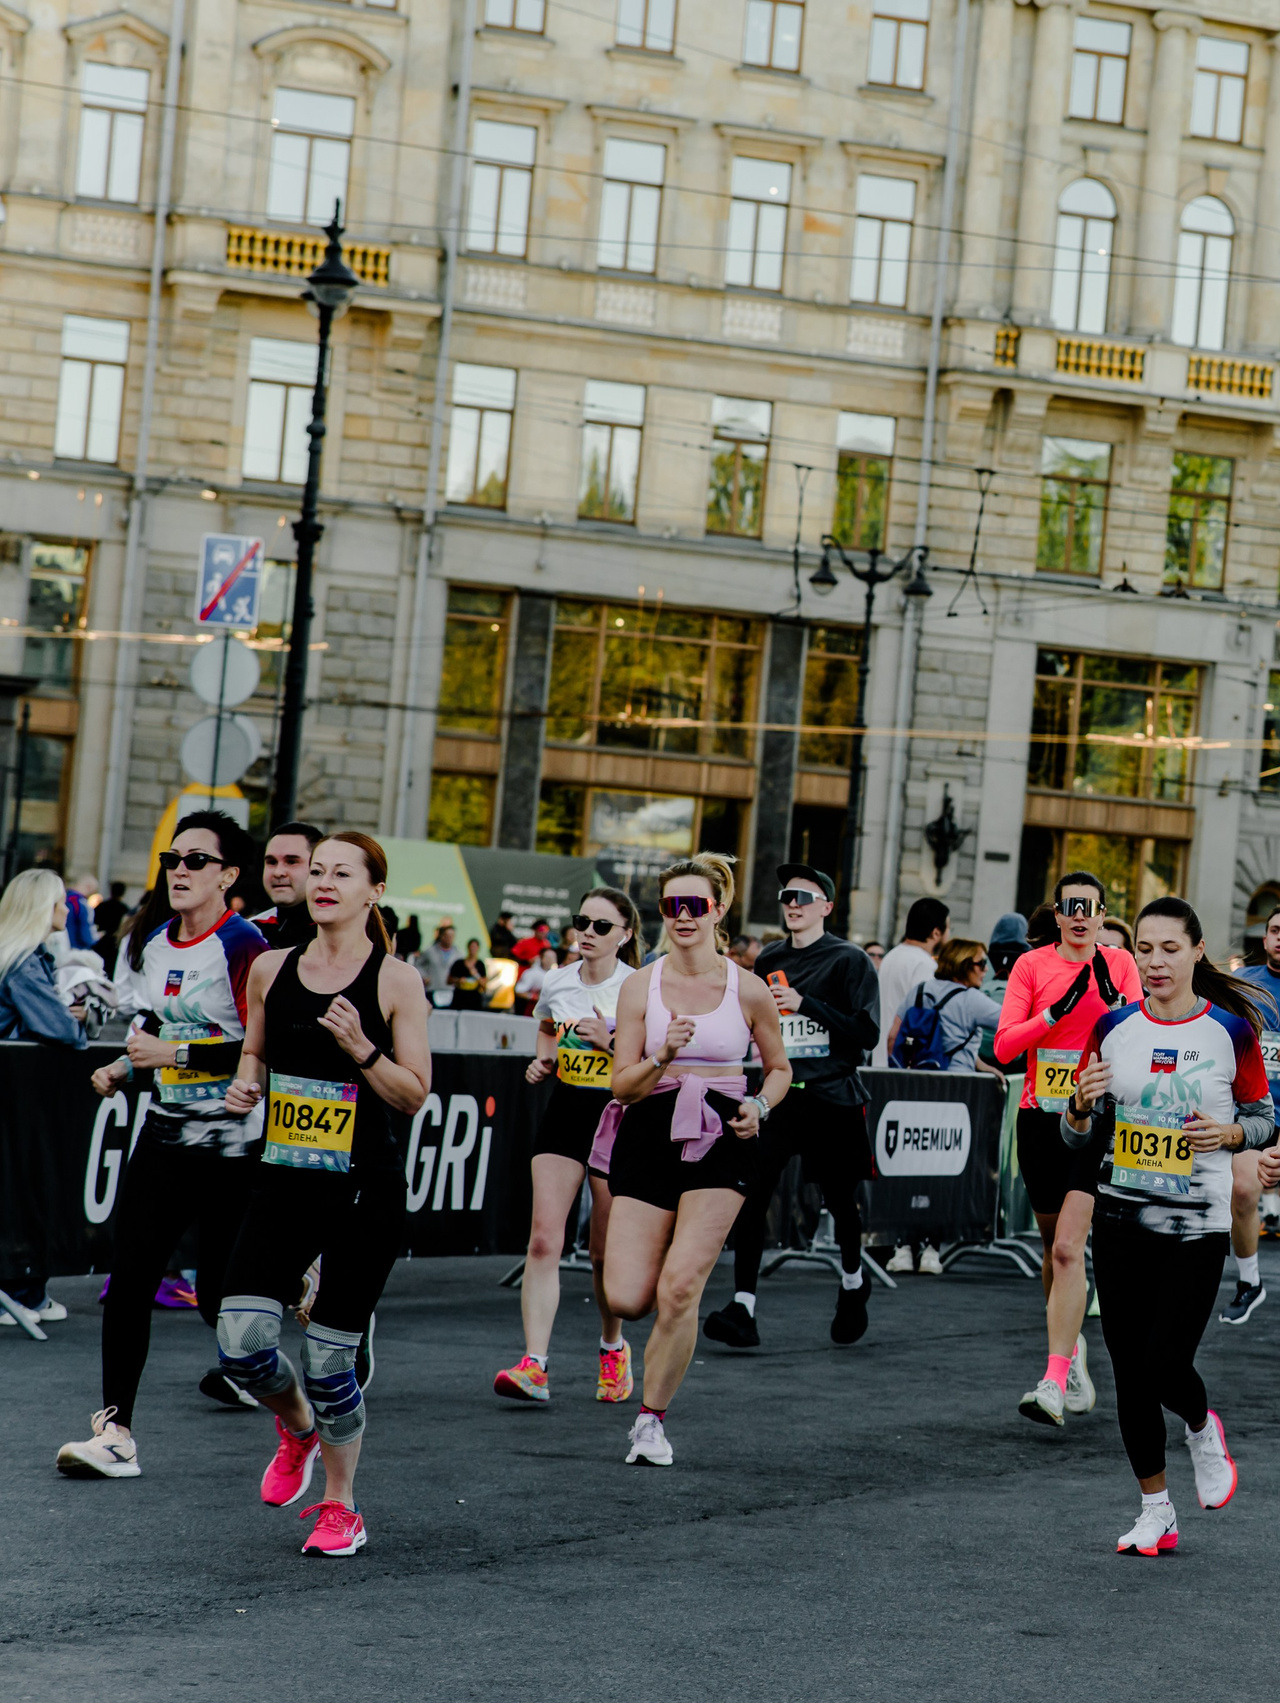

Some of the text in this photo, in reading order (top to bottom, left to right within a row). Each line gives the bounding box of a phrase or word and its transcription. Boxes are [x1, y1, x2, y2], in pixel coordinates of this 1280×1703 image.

[779, 1019, 828, 1037] 11154
[562, 1053, 609, 1076] 3472
[1183, 1050, 1200, 1062] GRi
[570, 1075, 595, 1083] КСЕНИЯ
[312, 1085, 321, 1093] 10
[273, 1100, 352, 1135] 10847
[1158, 1115, 1167, 1123] 10
[288, 1132, 318, 1143] ЕЛЕНА
[902, 1127, 963, 1151] PREMIUM
[1119, 1128, 1192, 1161] 10318
[83, 1089, 153, 1224] G
[404, 1092, 496, 1213] GRi
[1135, 1158, 1163, 1168] АЛЕНА
